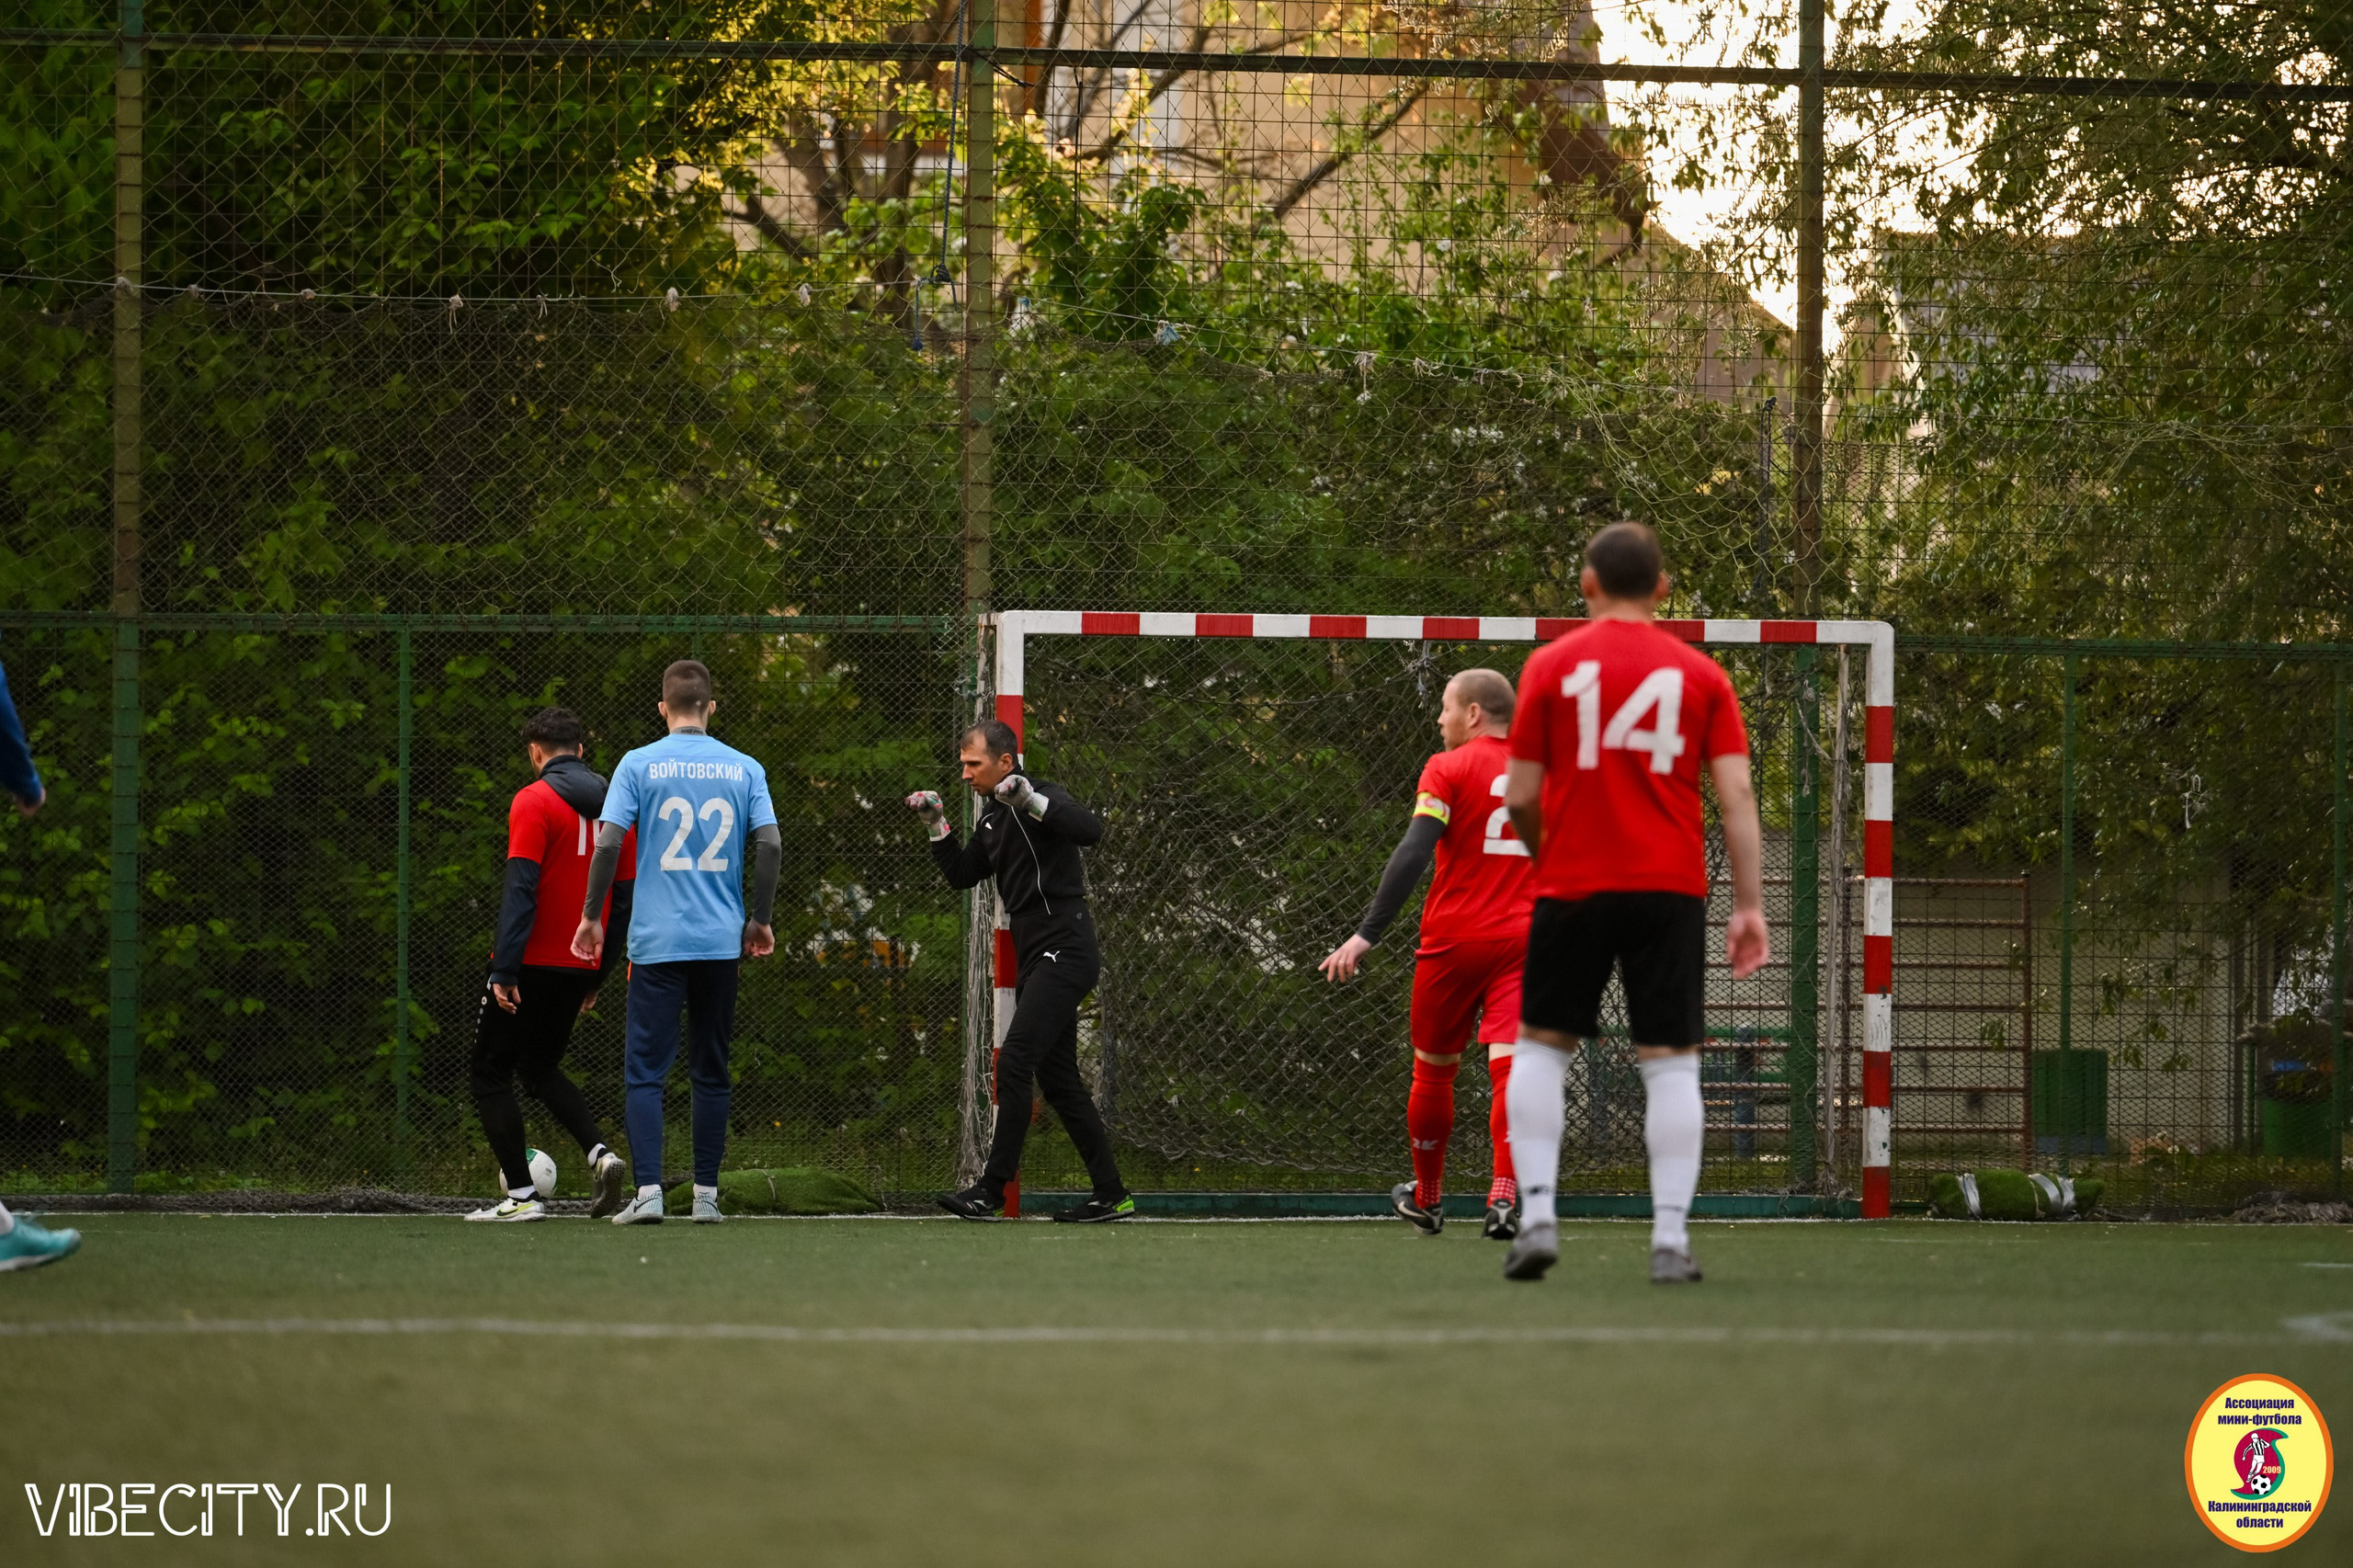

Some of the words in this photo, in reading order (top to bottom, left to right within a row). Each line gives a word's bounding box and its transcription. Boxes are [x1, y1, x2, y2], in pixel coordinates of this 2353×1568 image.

[1562, 660, 1686, 776] 14
[649, 758, 744, 782] ВОЙТОВСКИЙ
[658, 796, 734, 871] 22
